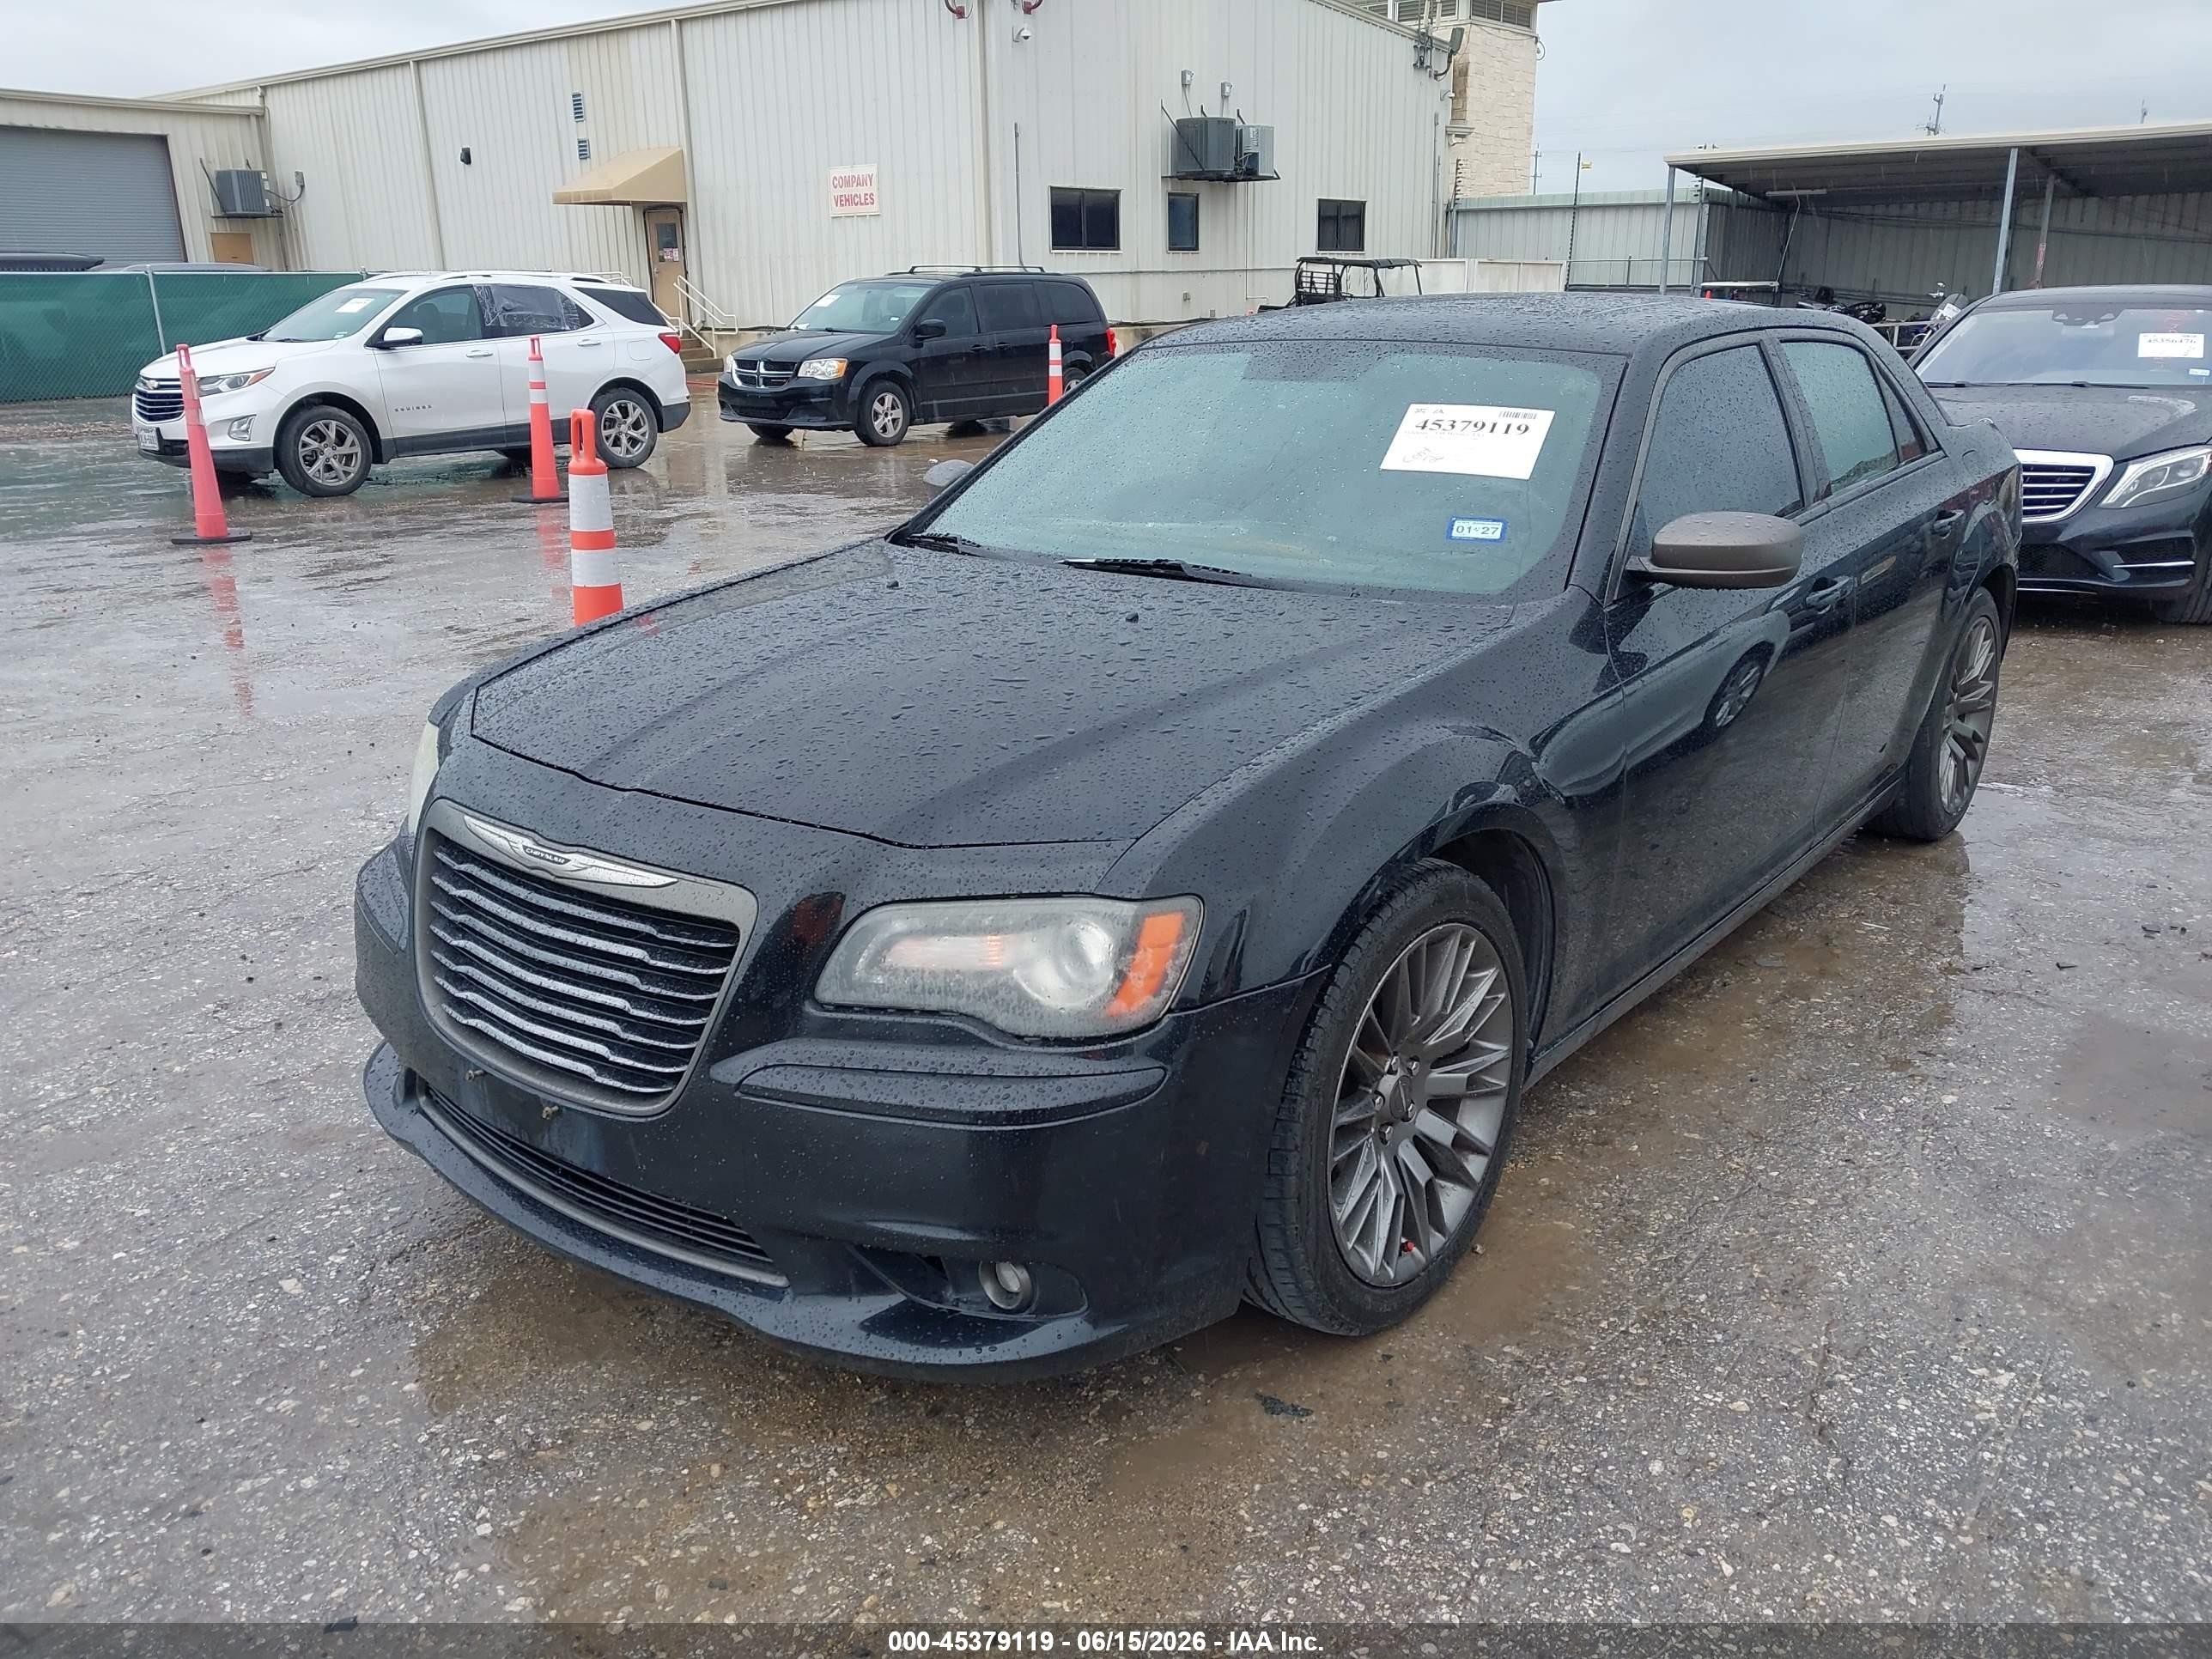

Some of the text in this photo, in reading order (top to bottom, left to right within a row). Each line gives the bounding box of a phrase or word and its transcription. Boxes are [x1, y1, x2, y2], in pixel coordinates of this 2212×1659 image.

[832, 173, 873, 189] COMPANY
[833, 192, 875, 207] VEHICLES
[1414, 418, 1530, 436] 45379119
